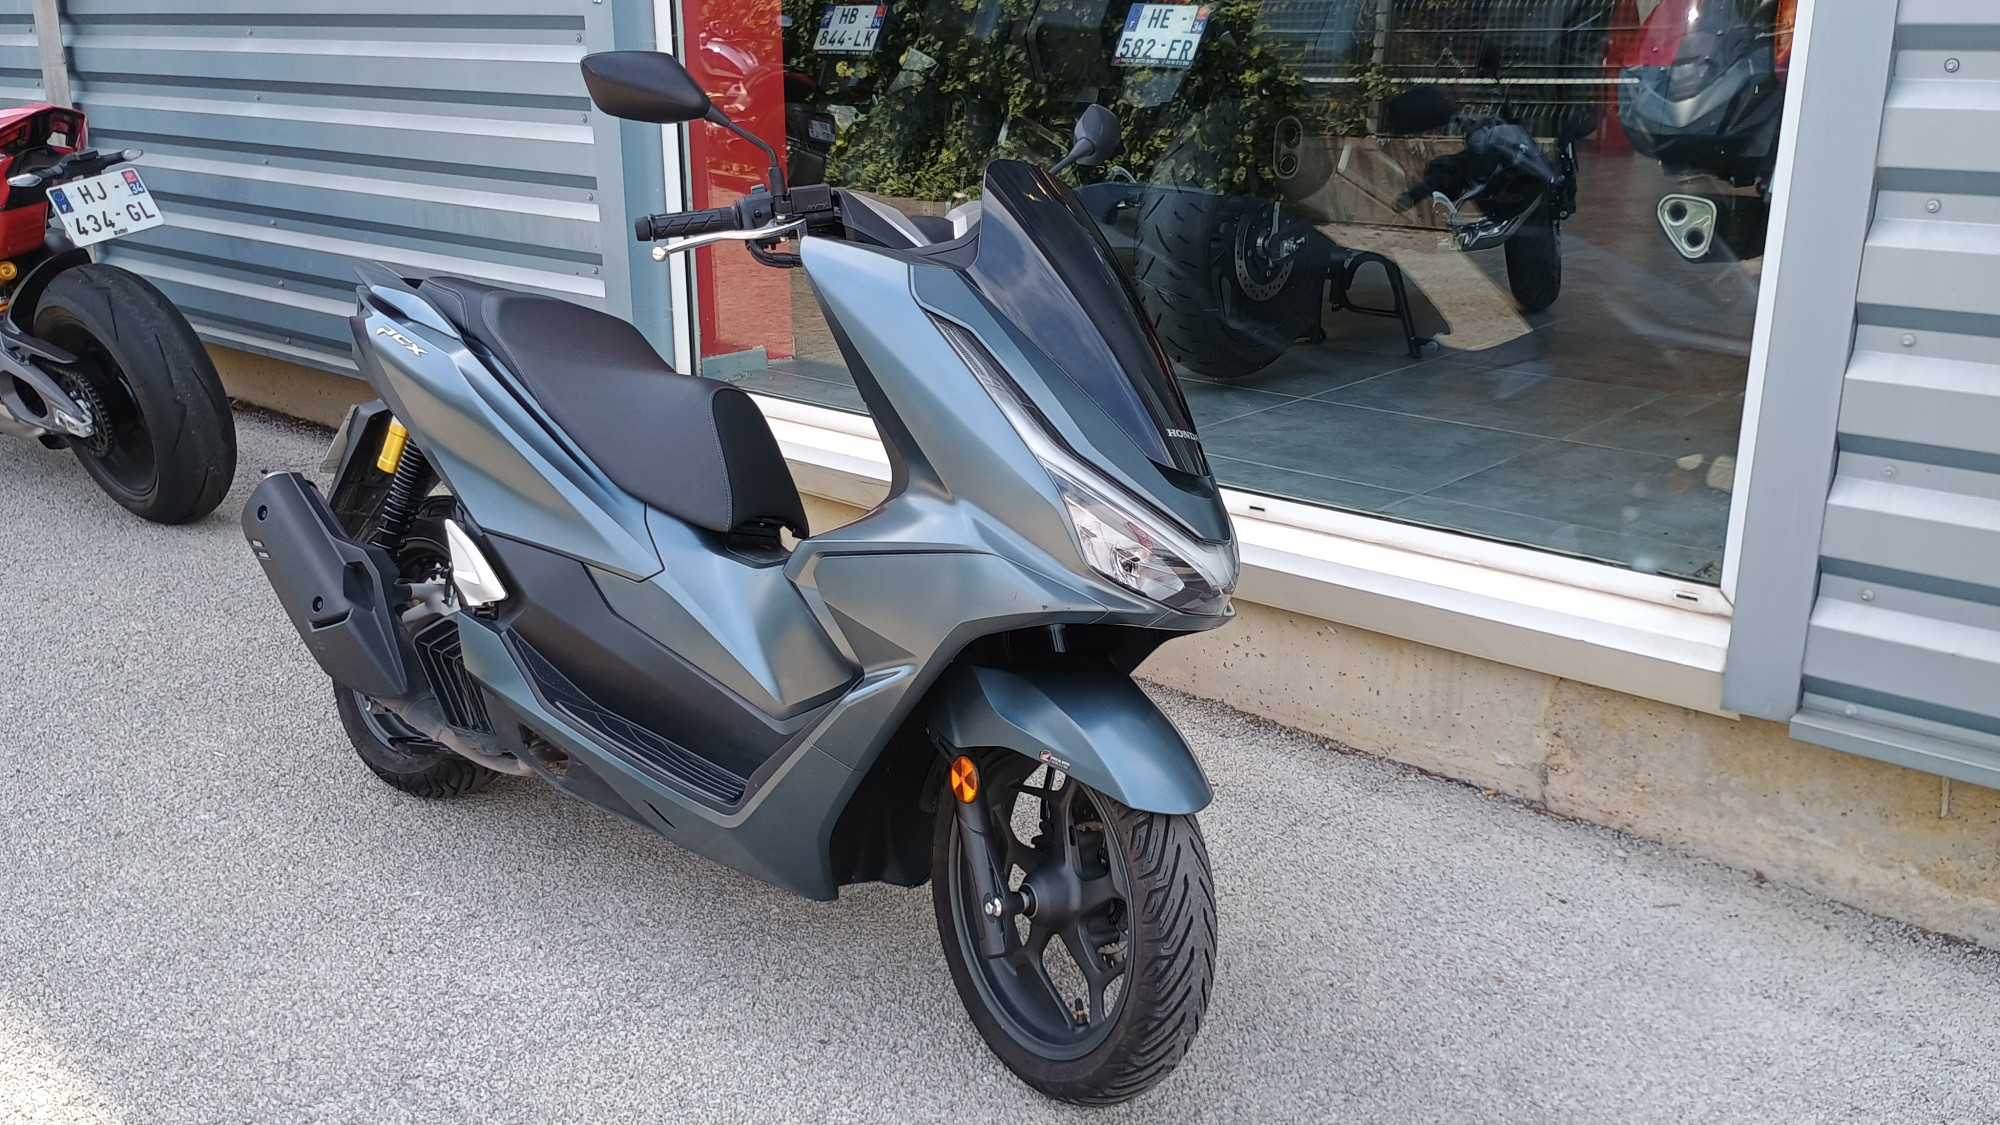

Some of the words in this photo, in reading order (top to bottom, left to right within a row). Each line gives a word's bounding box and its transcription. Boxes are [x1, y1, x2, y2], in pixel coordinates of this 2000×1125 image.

[839, 8, 859, 24] HB
[1129, 20, 1135, 28] F
[1147, 8, 1174, 29] HE
[1192, 21, 1203, 31] 34
[819, 30, 875, 47] 844-LK
[1119, 37, 1193, 60] 582-FR
[77, 181, 108, 205] HJ
[129, 182, 144, 193] 34
[75, 201, 156, 236] 434-GL
[376, 322, 429, 357] PCX
